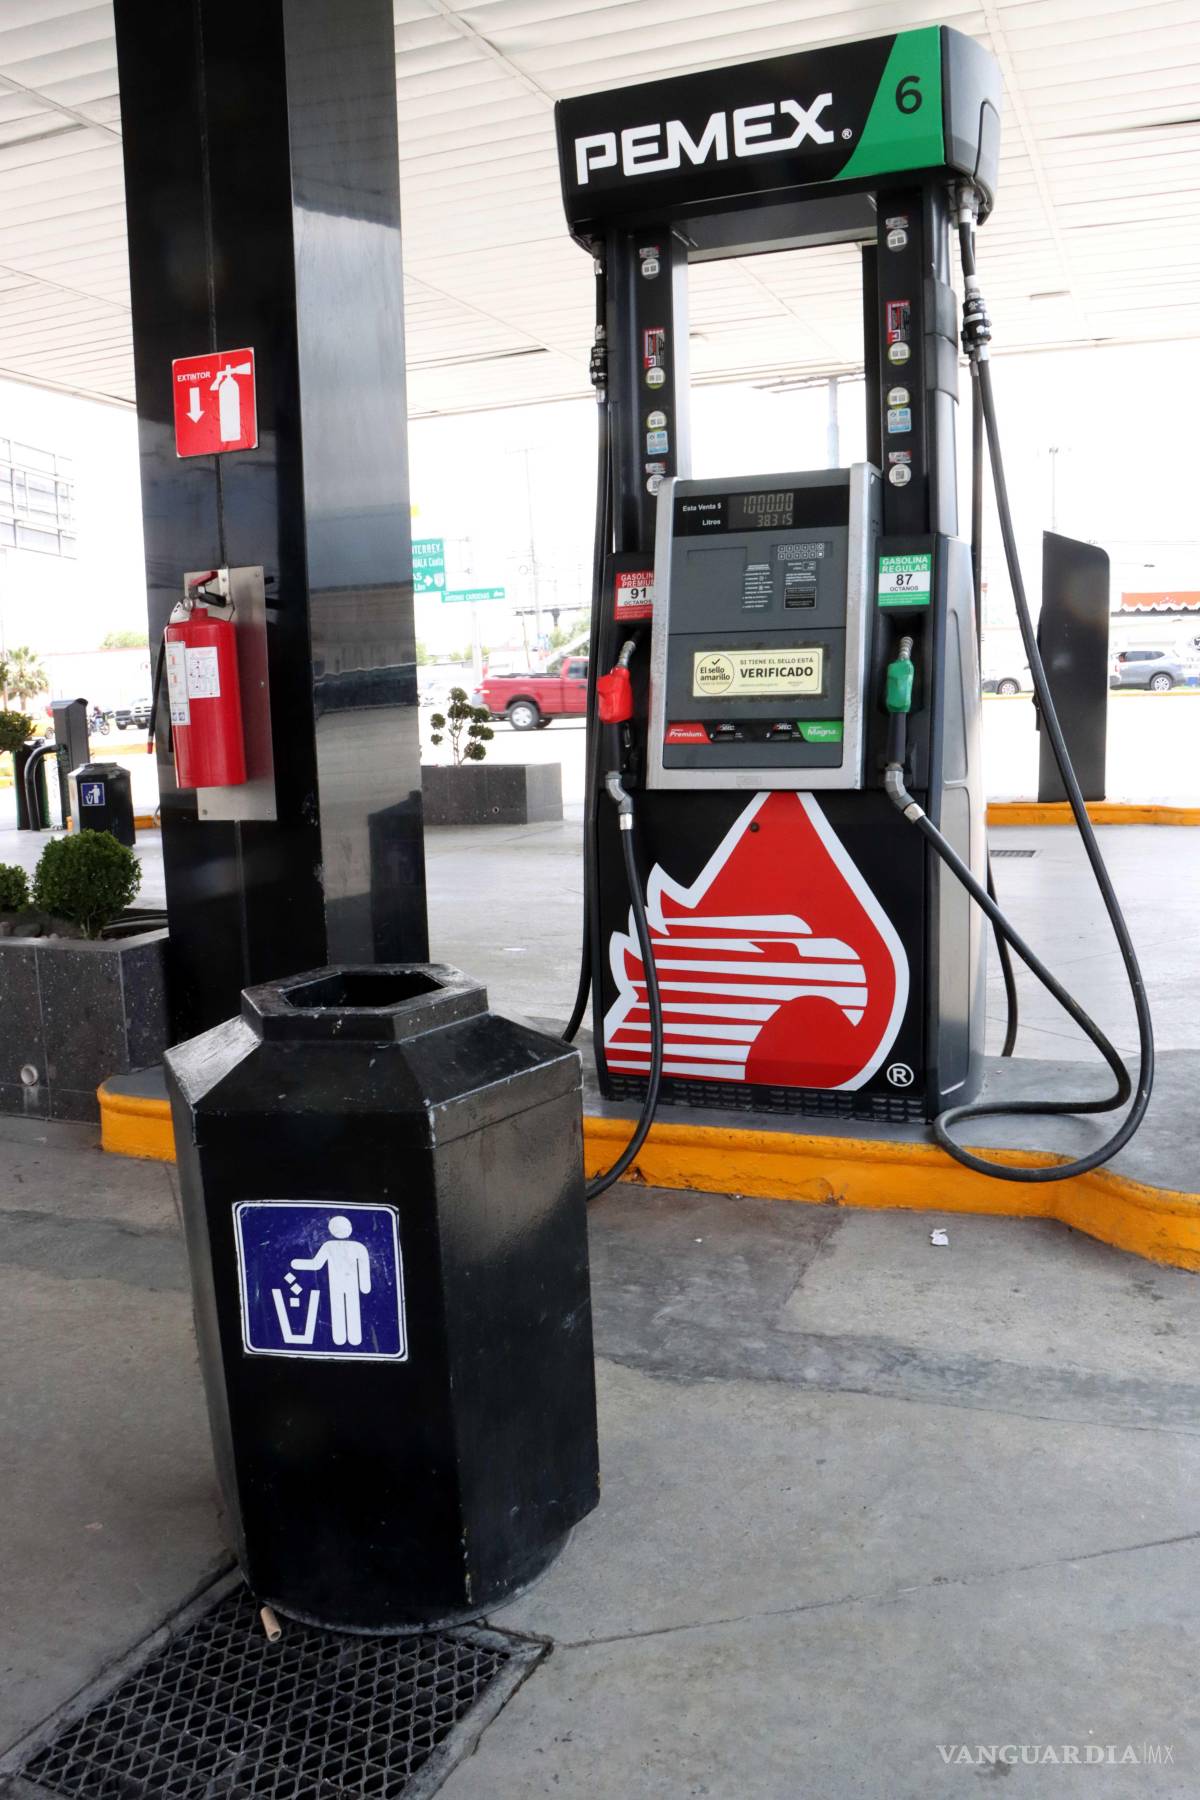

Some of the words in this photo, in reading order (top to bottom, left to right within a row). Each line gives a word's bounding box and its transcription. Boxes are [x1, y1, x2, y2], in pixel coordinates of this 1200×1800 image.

[896, 75, 923, 115] 6
[574, 92, 835, 186] PEMEX
[177, 371, 211, 382] EXTINTOR
[698, 503, 716, 511] Venta
[882, 556, 929, 565] GASOLINA
[881, 564, 928, 573] REGULAR
[621, 571, 654, 581] GASOLIN
[896, 573, 913, 586] 87
[621, 580, 654, 588] PREMIU
[630, 587, 647, 599] 91
[700, 673, 731, 681] amarillo
[740, 666, 814, 678] VERIFICADO
[807, 728, 837, 737] Magna
